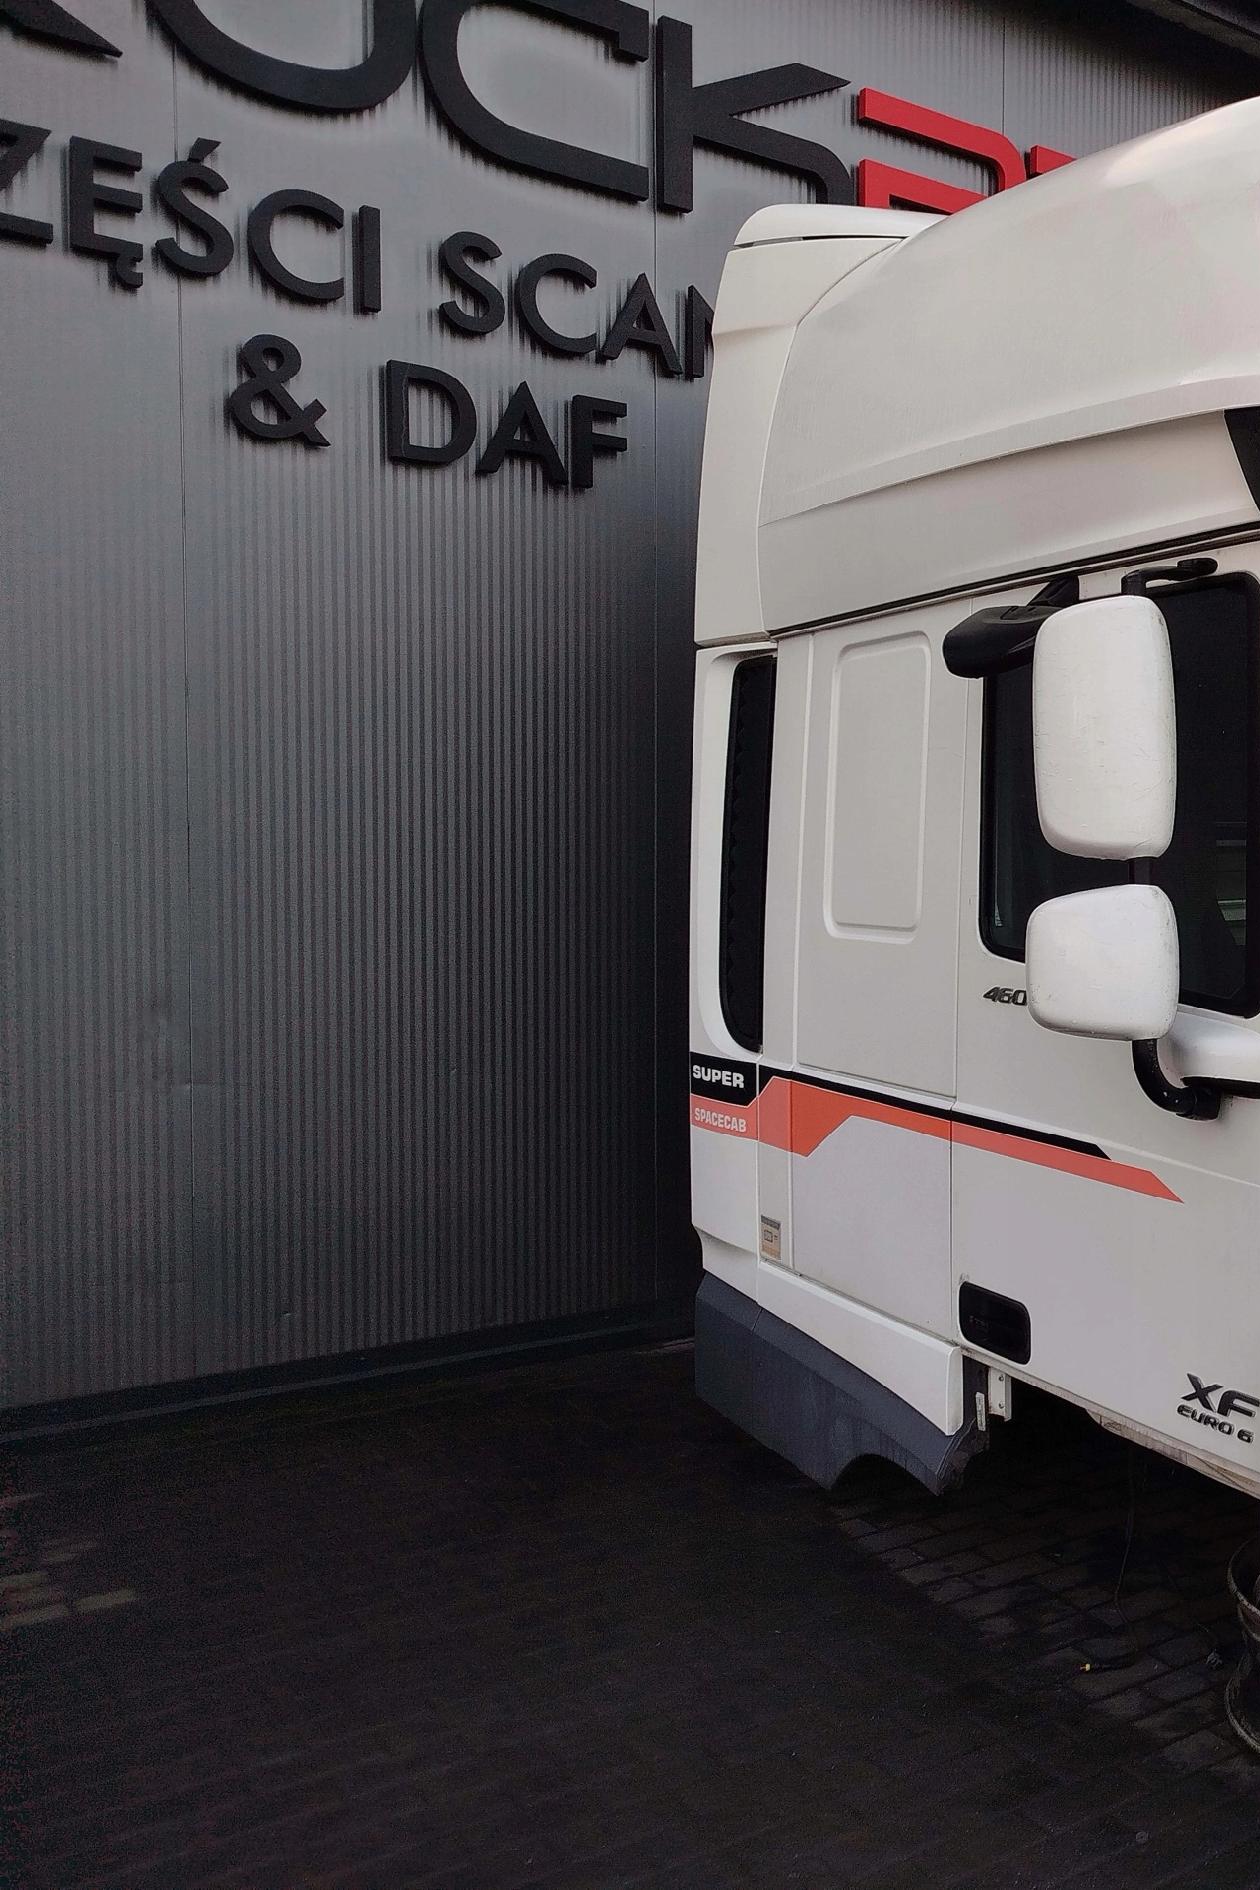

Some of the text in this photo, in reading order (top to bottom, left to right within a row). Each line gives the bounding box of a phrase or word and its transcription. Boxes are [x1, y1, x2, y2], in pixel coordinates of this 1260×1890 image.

[229, 333, 627, 488] & DAF
[983, 986, 1027, 1006] 460
[692, 1064, 745, 1089] SUPER
[694, 1107, 747, 1133] SPACECAB
[1177, 1404, 1254, 1444] EURO 6
